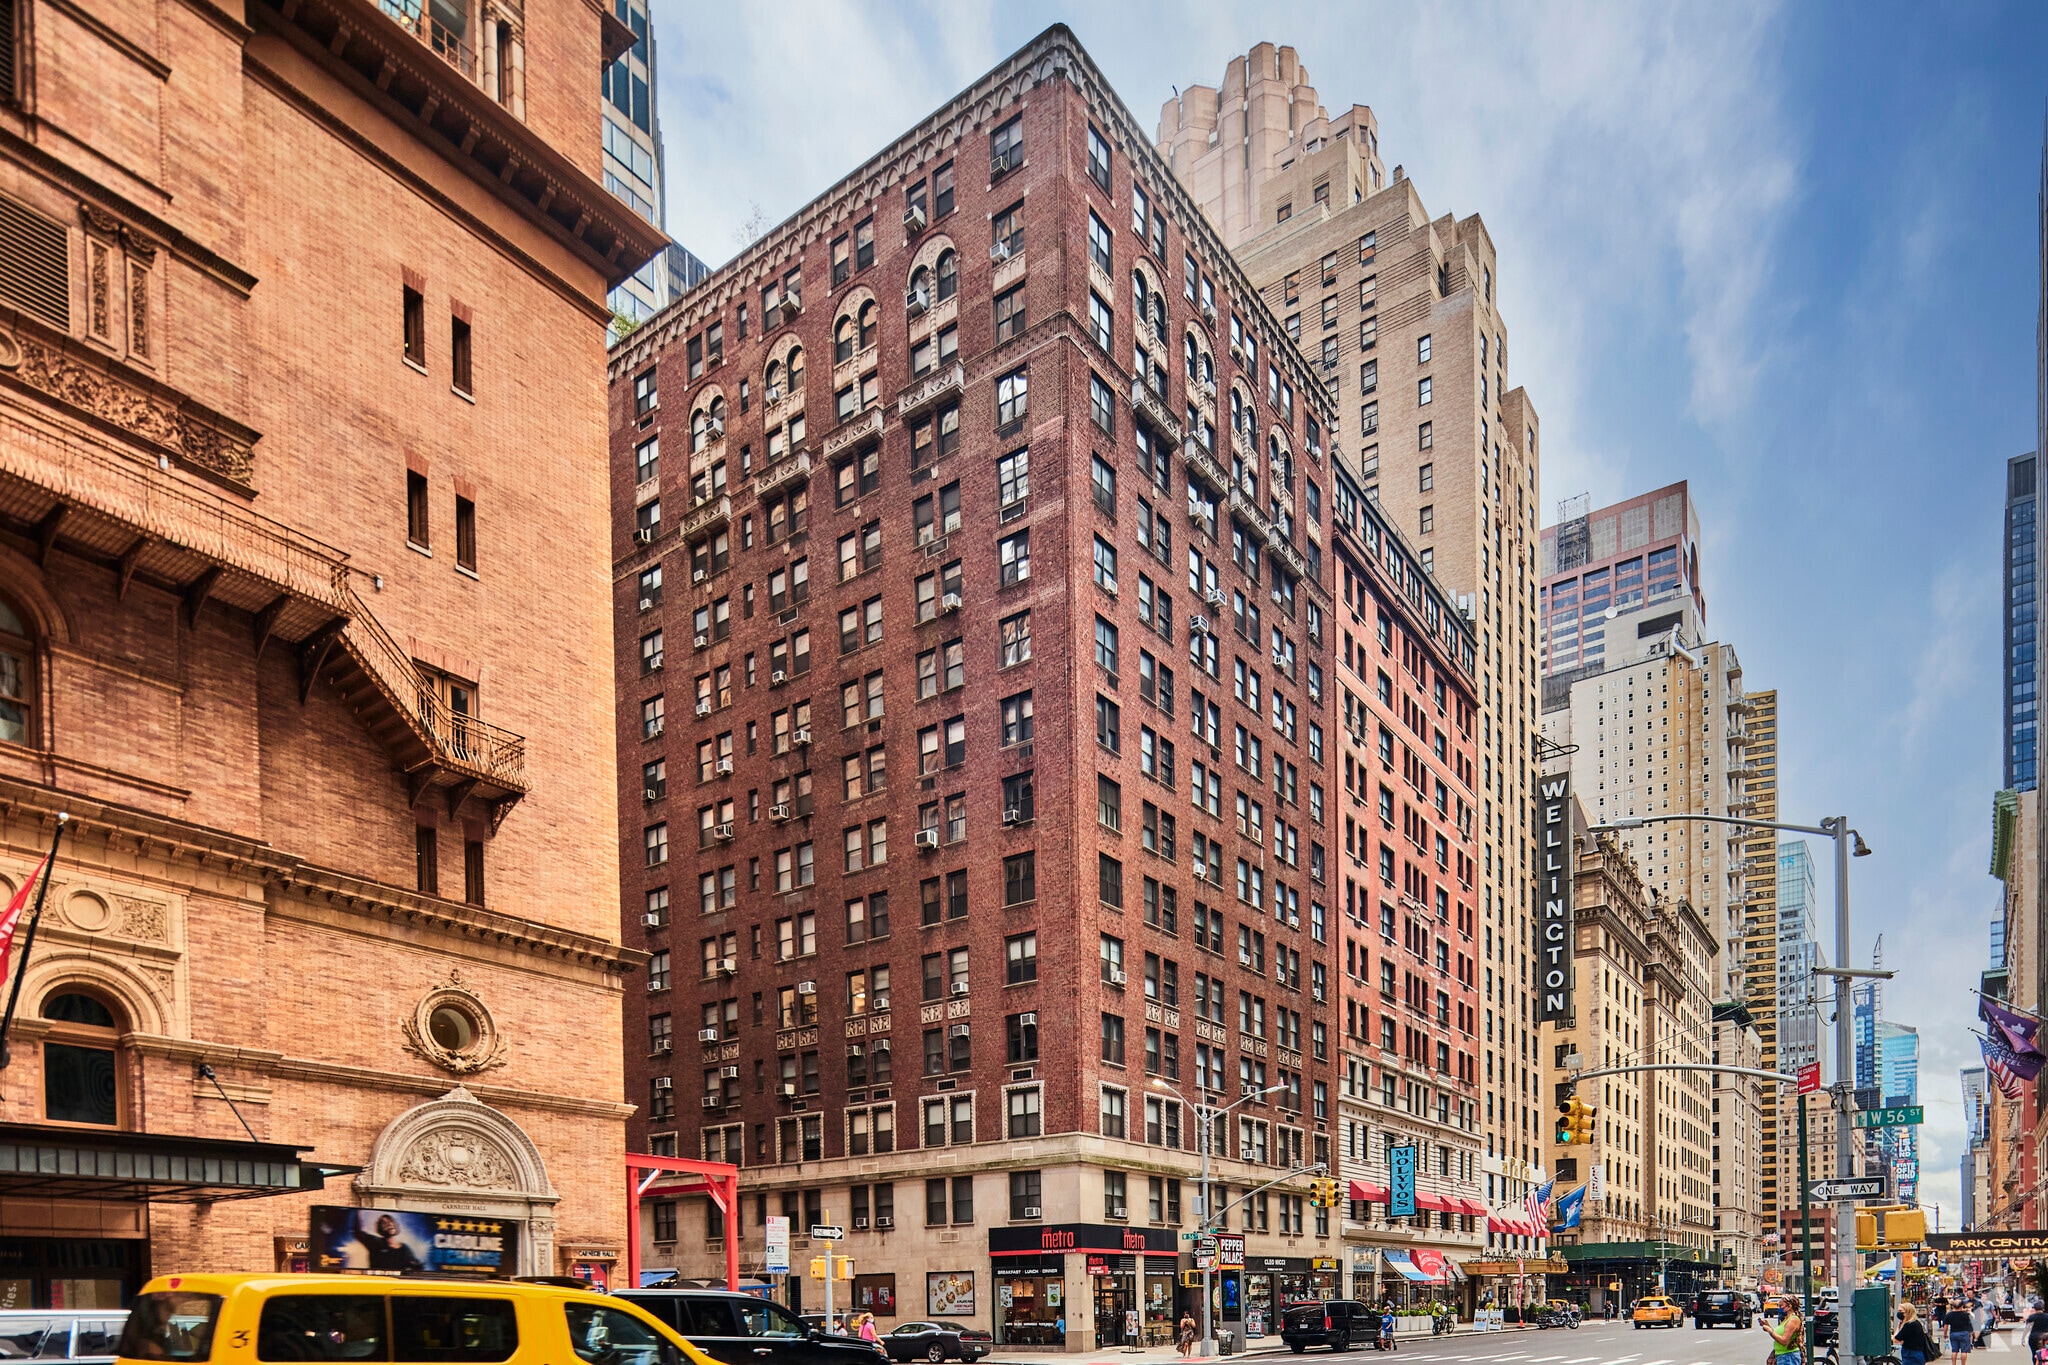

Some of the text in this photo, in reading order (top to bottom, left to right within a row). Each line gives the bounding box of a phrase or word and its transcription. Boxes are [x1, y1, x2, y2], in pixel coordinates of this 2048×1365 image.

[1541, 778, 1567, 1012] WELLINGTON
[1871, 1108, 1921, 1125] W 56 ST
[1395, 1149, 1409, 1208] MOLYVOS
[1817, 1183, 1875, 1195] ONE WAY
[1041, 1230, 1074, 1249] metro
[1123, 1233, 1146, 1250] metro
[1221, 1239, 1244, 1251] PEPPER
[1950, 1239, 1987, 1249] PARK
[1221, 1251, 1244, 1264] PALACE
